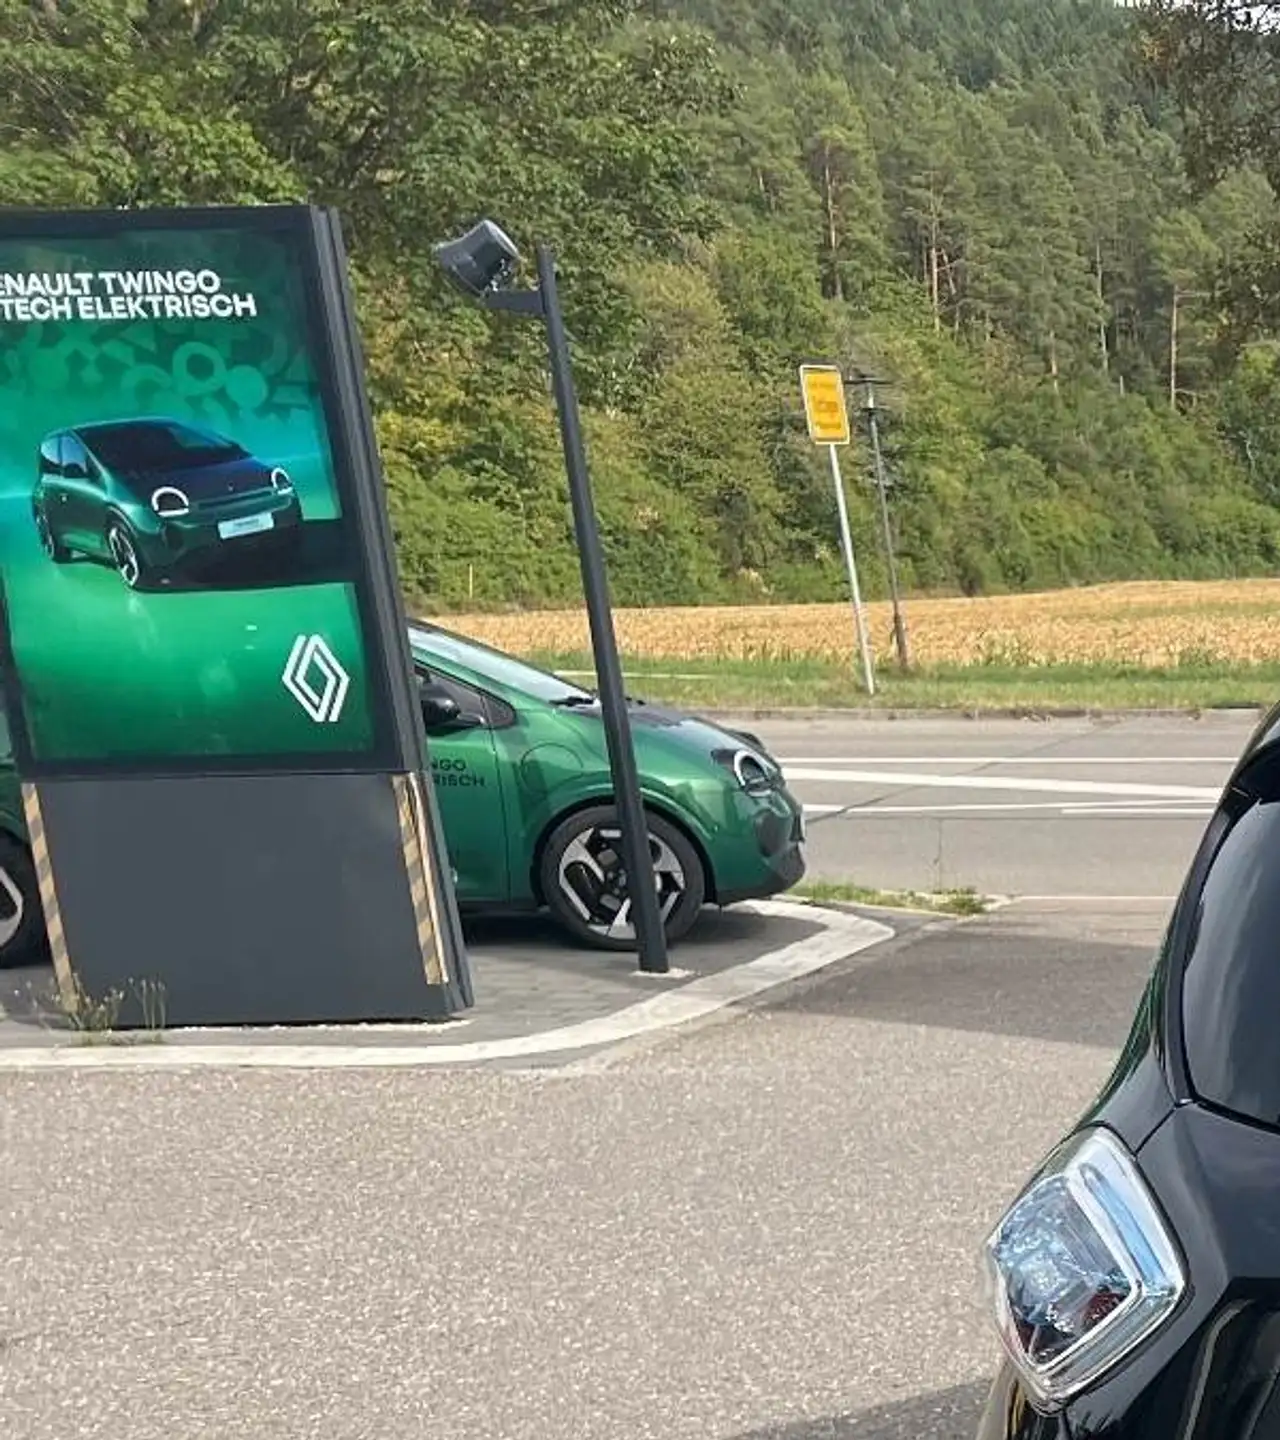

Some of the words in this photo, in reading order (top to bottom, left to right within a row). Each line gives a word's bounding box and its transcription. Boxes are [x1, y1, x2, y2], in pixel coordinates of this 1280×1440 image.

[98, 269, 221, 295] TWINGO
[0, 296, 73, 321] TECH
[77, 293, 257, 320] ELEKTRISCH
